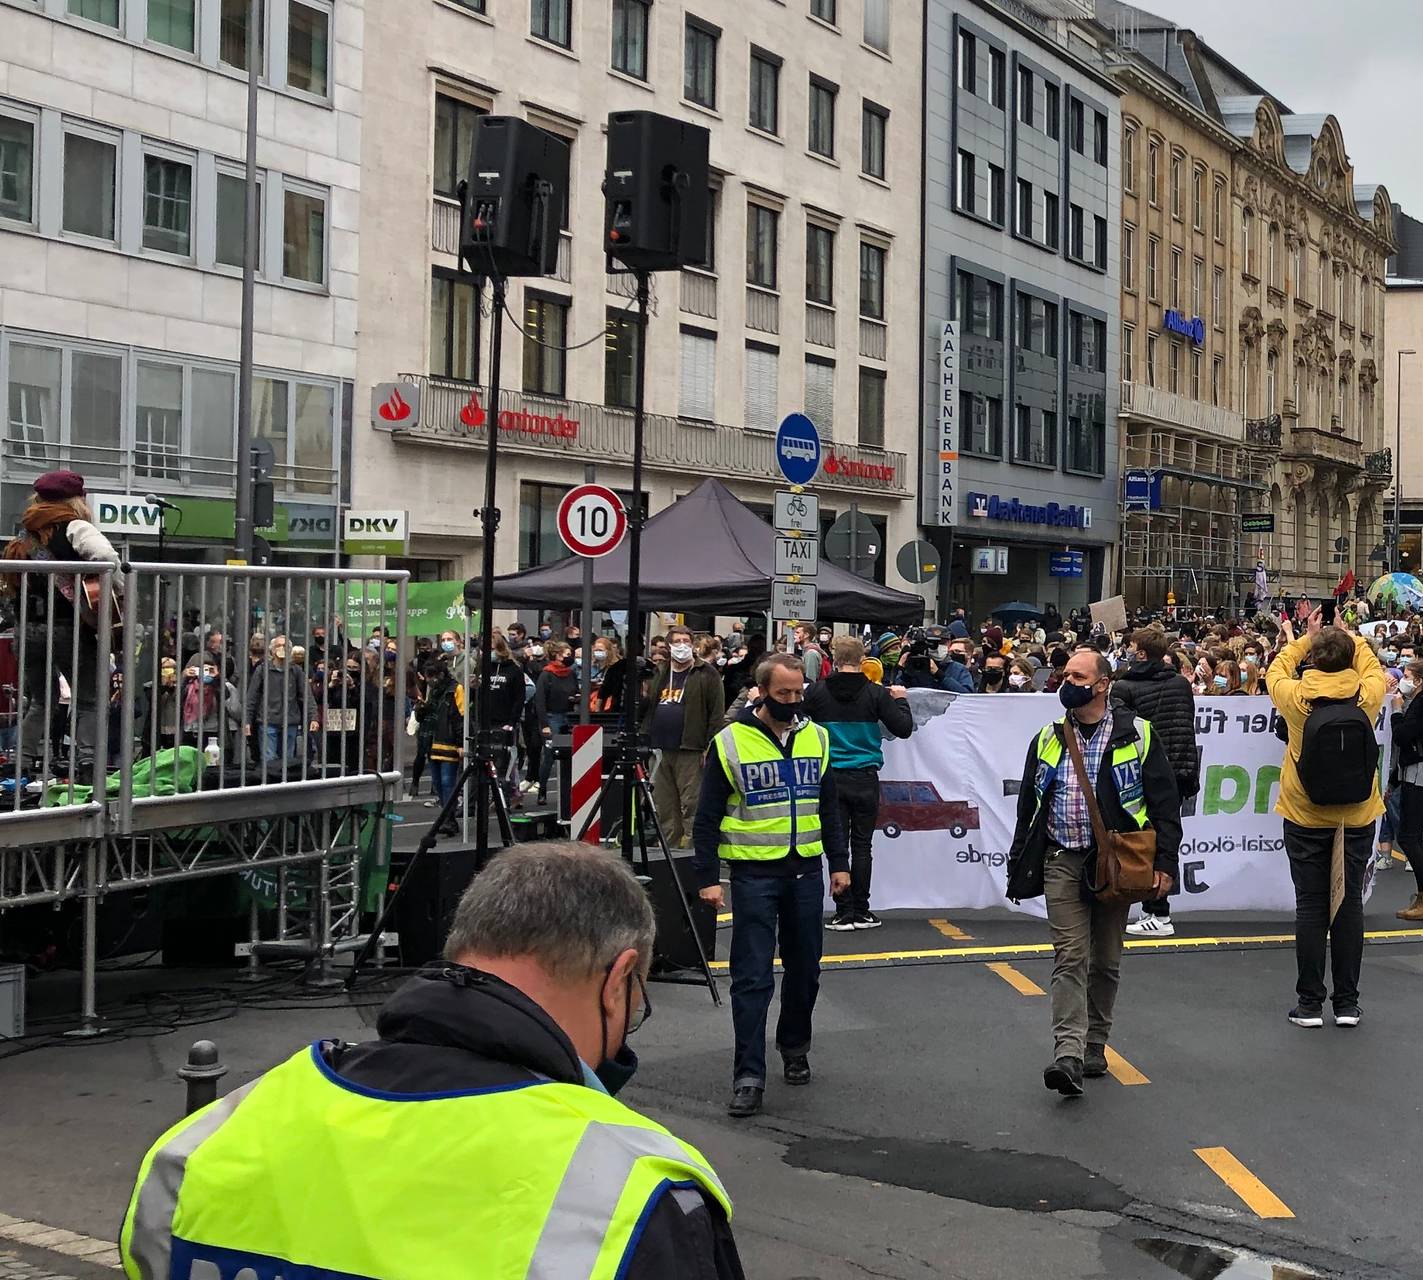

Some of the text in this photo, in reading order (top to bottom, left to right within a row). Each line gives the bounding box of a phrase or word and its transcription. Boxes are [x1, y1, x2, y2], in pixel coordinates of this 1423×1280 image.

[498, 407, 580, 438] antander
[941, 323, 955, 524] AACHENER BANK
[841, 455, 896, 482] Santander
[1127, 475, 1147, 483] Allianz
[100, 503, 160, 526] DKV
[576, 505, 608, 537] 10
[350, 518, 398, 533] DKV
[790, 518, 802, 528] frei
[783, 541, 811, 559] TAXI
[791, 563, 803, 573] frei
[783, 585, 806, 596] Liefer-
[782, 599, 806, 608] verkehr
[788, 609, 800, 618] frei
